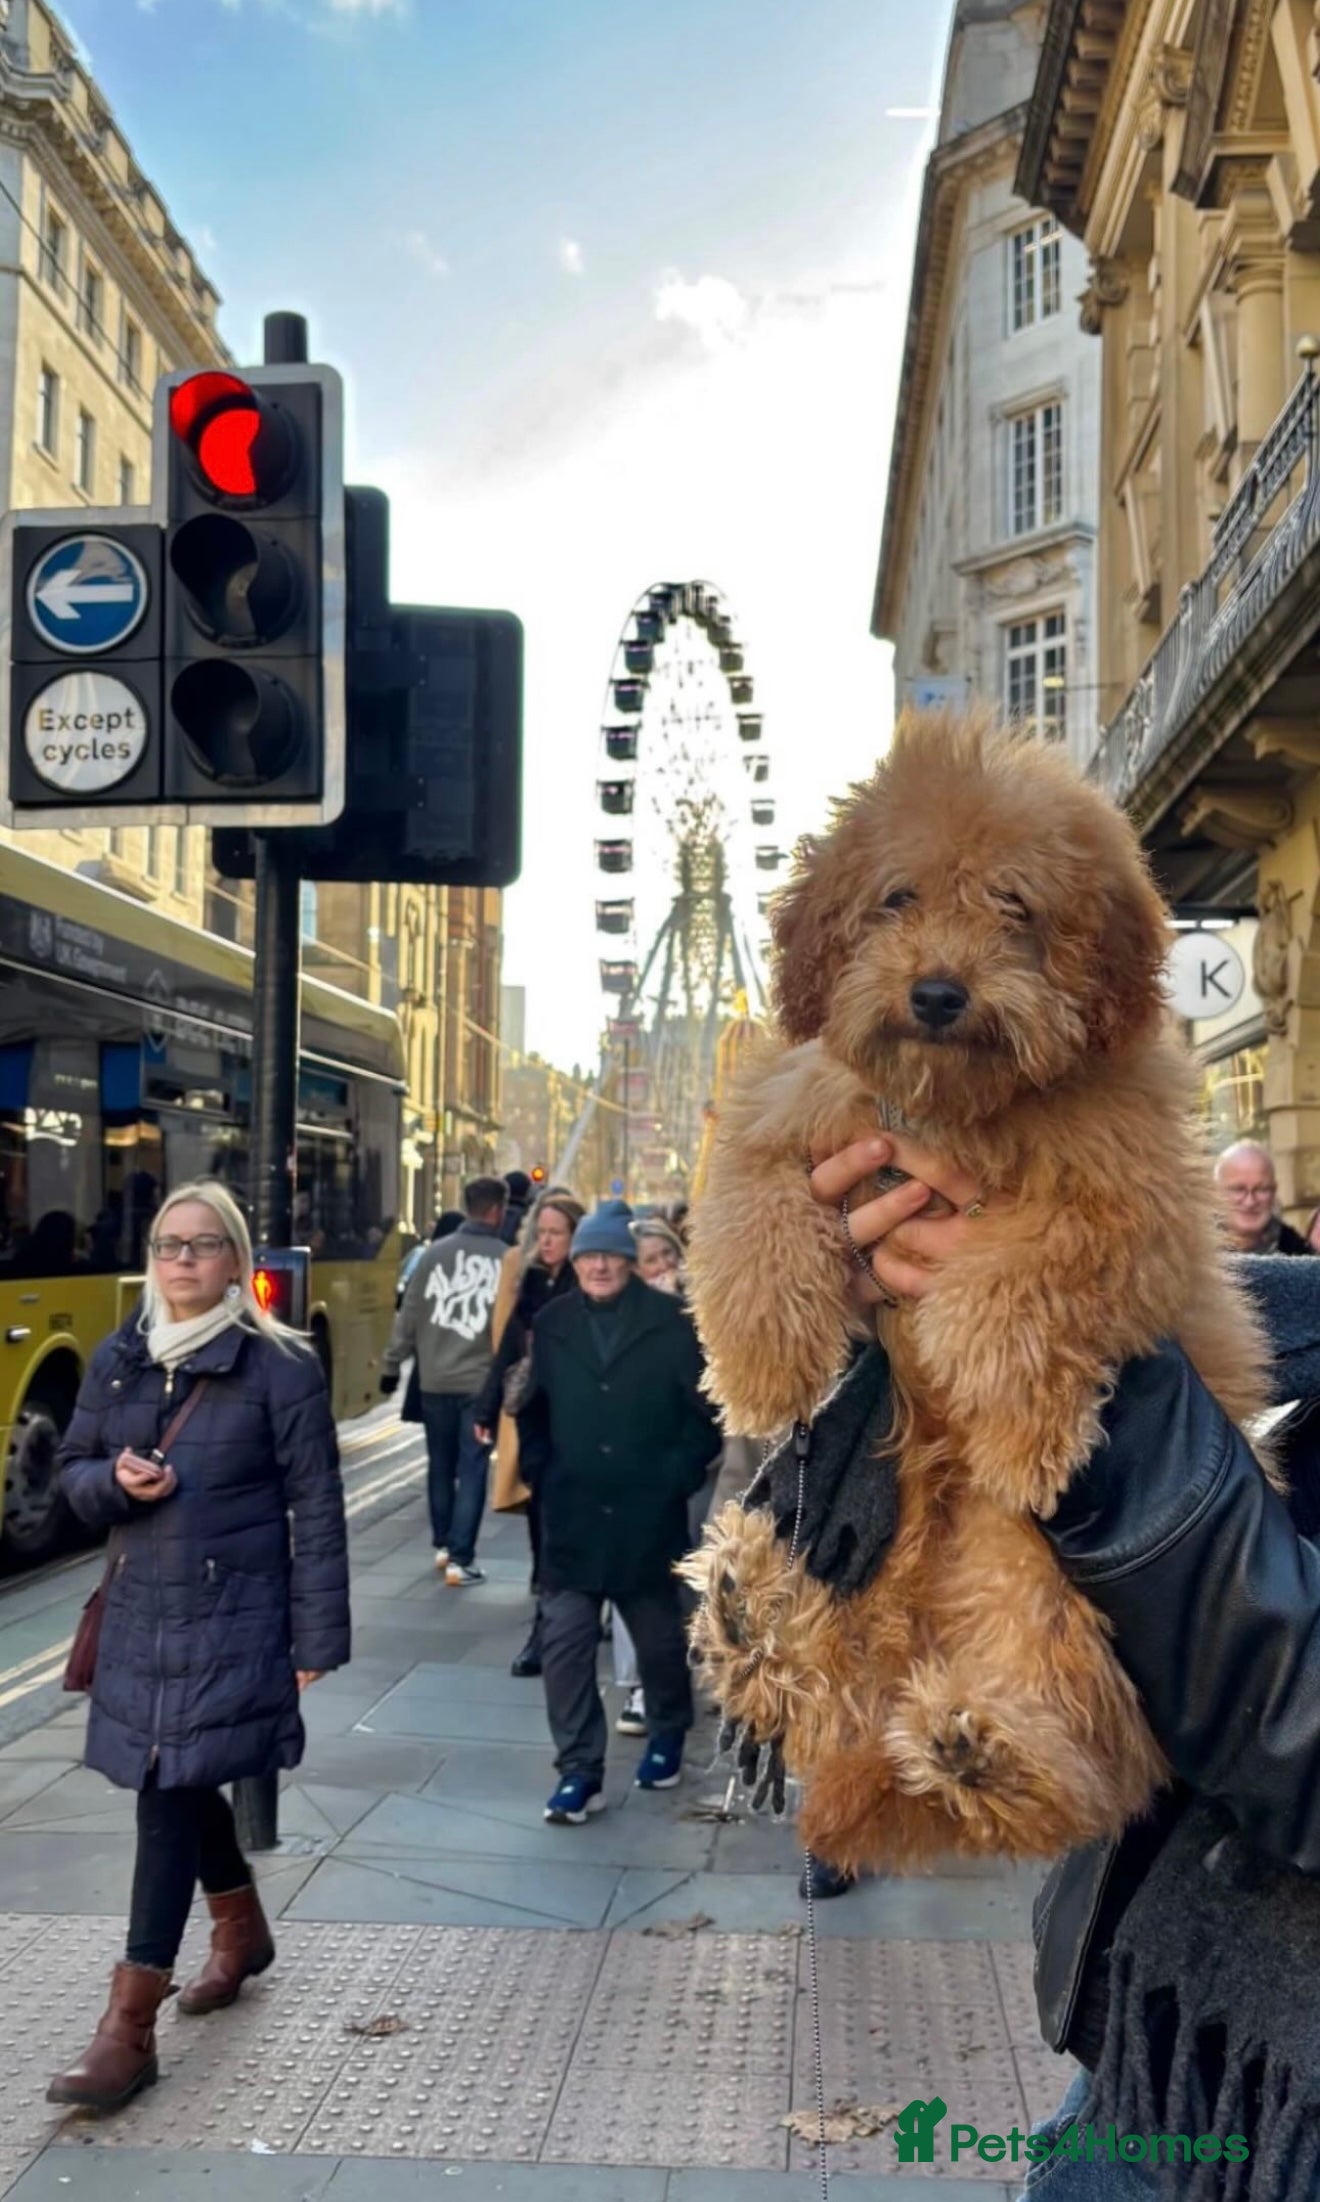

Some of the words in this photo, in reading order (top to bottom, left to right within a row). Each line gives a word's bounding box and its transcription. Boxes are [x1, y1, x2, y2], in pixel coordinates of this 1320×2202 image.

[38, 707, 136, 733] Except
[43, 737, 131, 765] cycles
[1201, 960, 1231, 998] K
